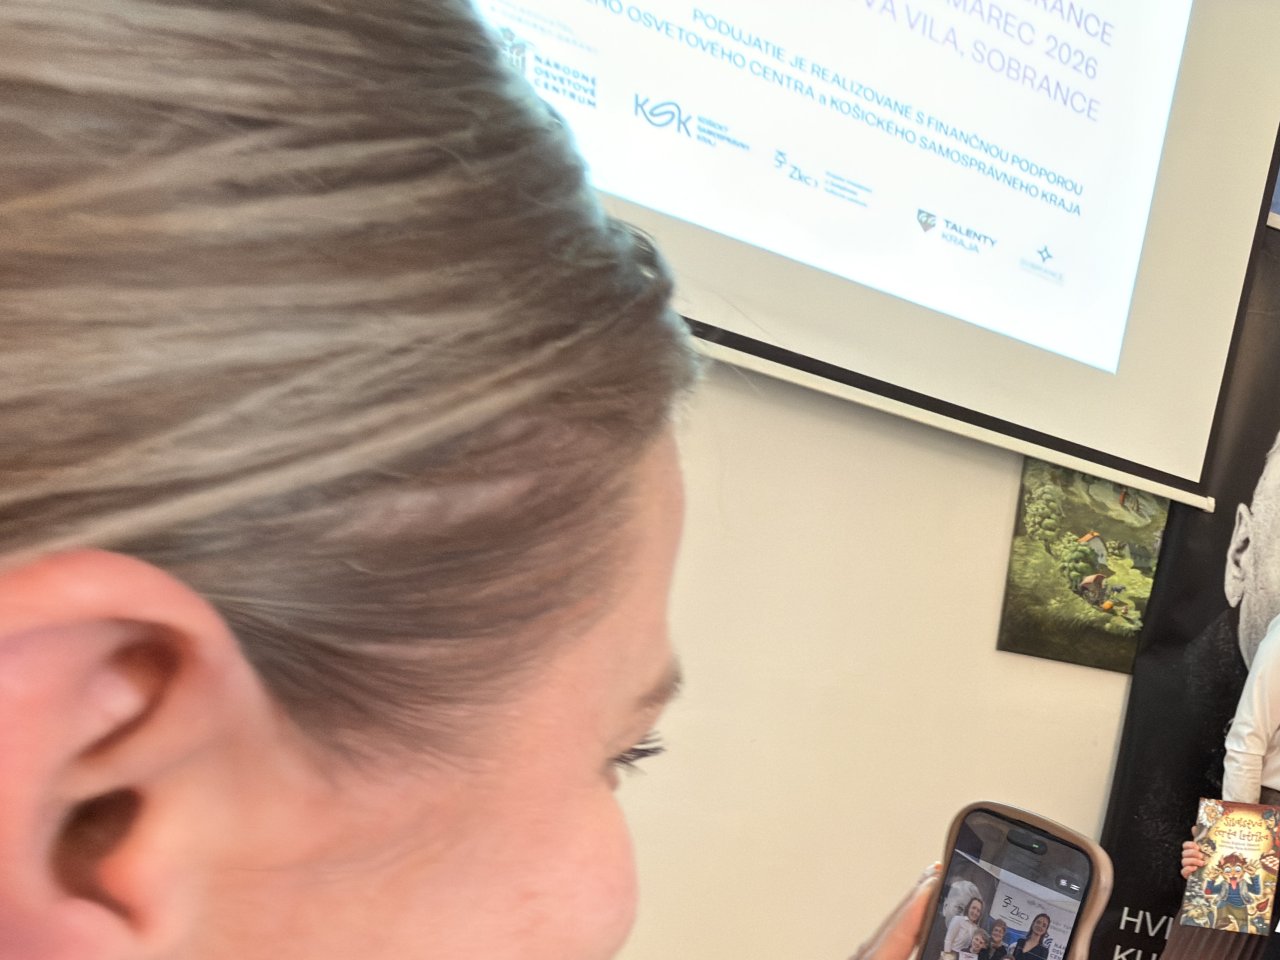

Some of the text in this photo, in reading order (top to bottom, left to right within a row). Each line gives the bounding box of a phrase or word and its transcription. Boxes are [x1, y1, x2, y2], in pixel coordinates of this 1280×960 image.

[692, 8, 787, 63] PODUJATIE
[789, 53, 808, 73] JE
[914, 109, 926, 126] S
[927, 114, 1010, 164] FINANČNOU
[1010, 153, 1084, 197] PODPOROU
[904, 3, 966, 57] VILA,
[970, 39, 1101, 122] SOBRANCE
[1043, 33, 1100, 80] 2026
[749, 60, 815, 101] CENTRA
[1040, 190, 1082, 217] KRAJA
[944, 218, 998, 248] TALENTY
